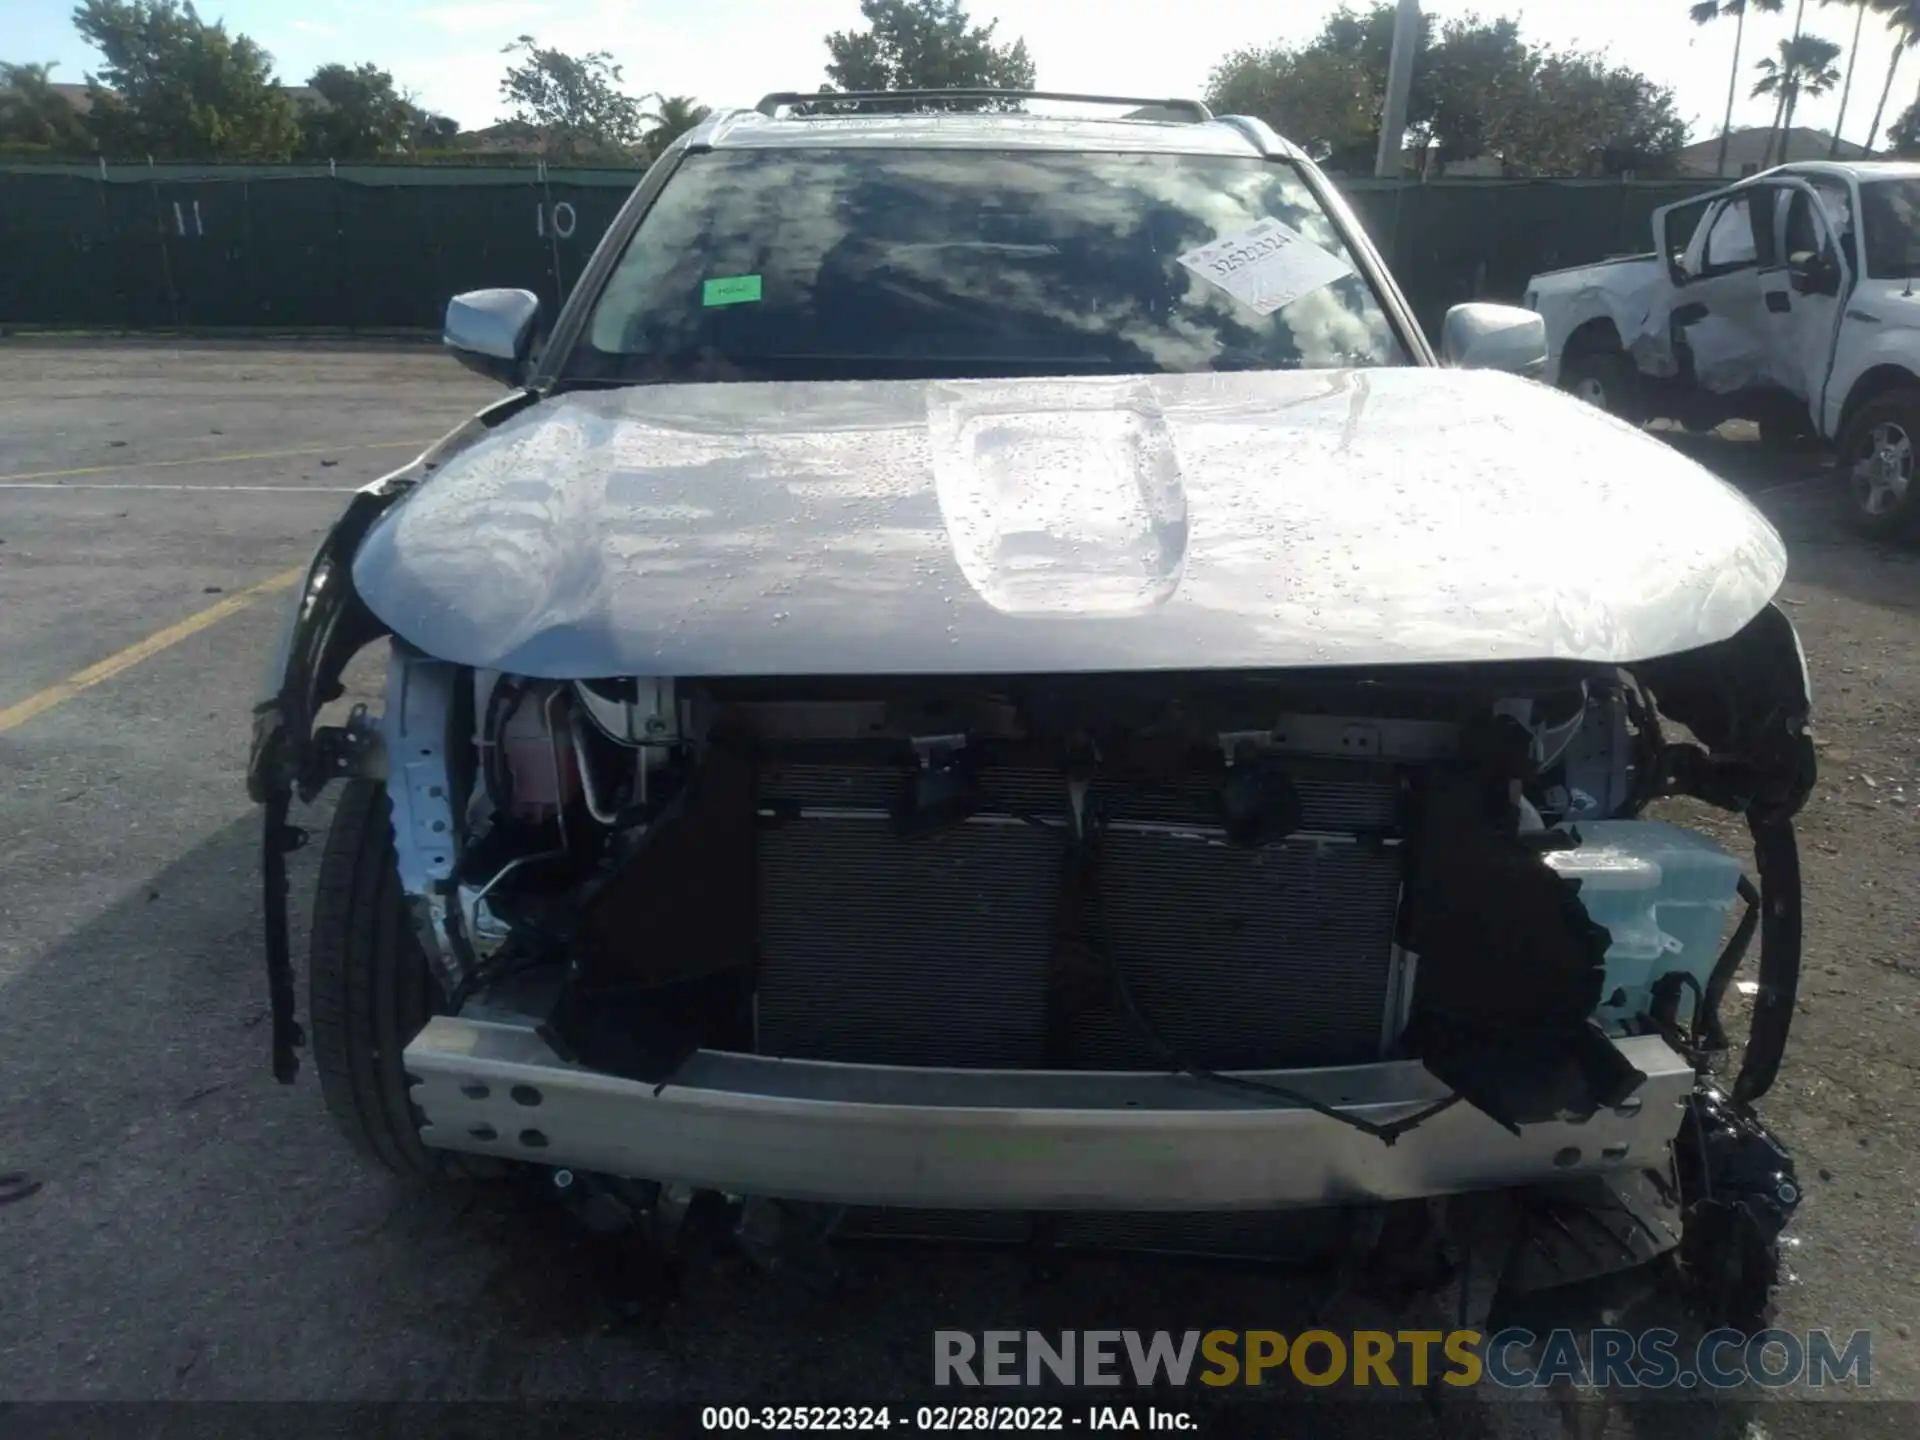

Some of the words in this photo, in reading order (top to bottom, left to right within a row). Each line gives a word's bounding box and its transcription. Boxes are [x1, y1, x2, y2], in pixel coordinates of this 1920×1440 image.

[173, 201, 204, 236] 11
[537, 201, 577, 238] 10
[1208, 232, 1292, 276] 32522324
